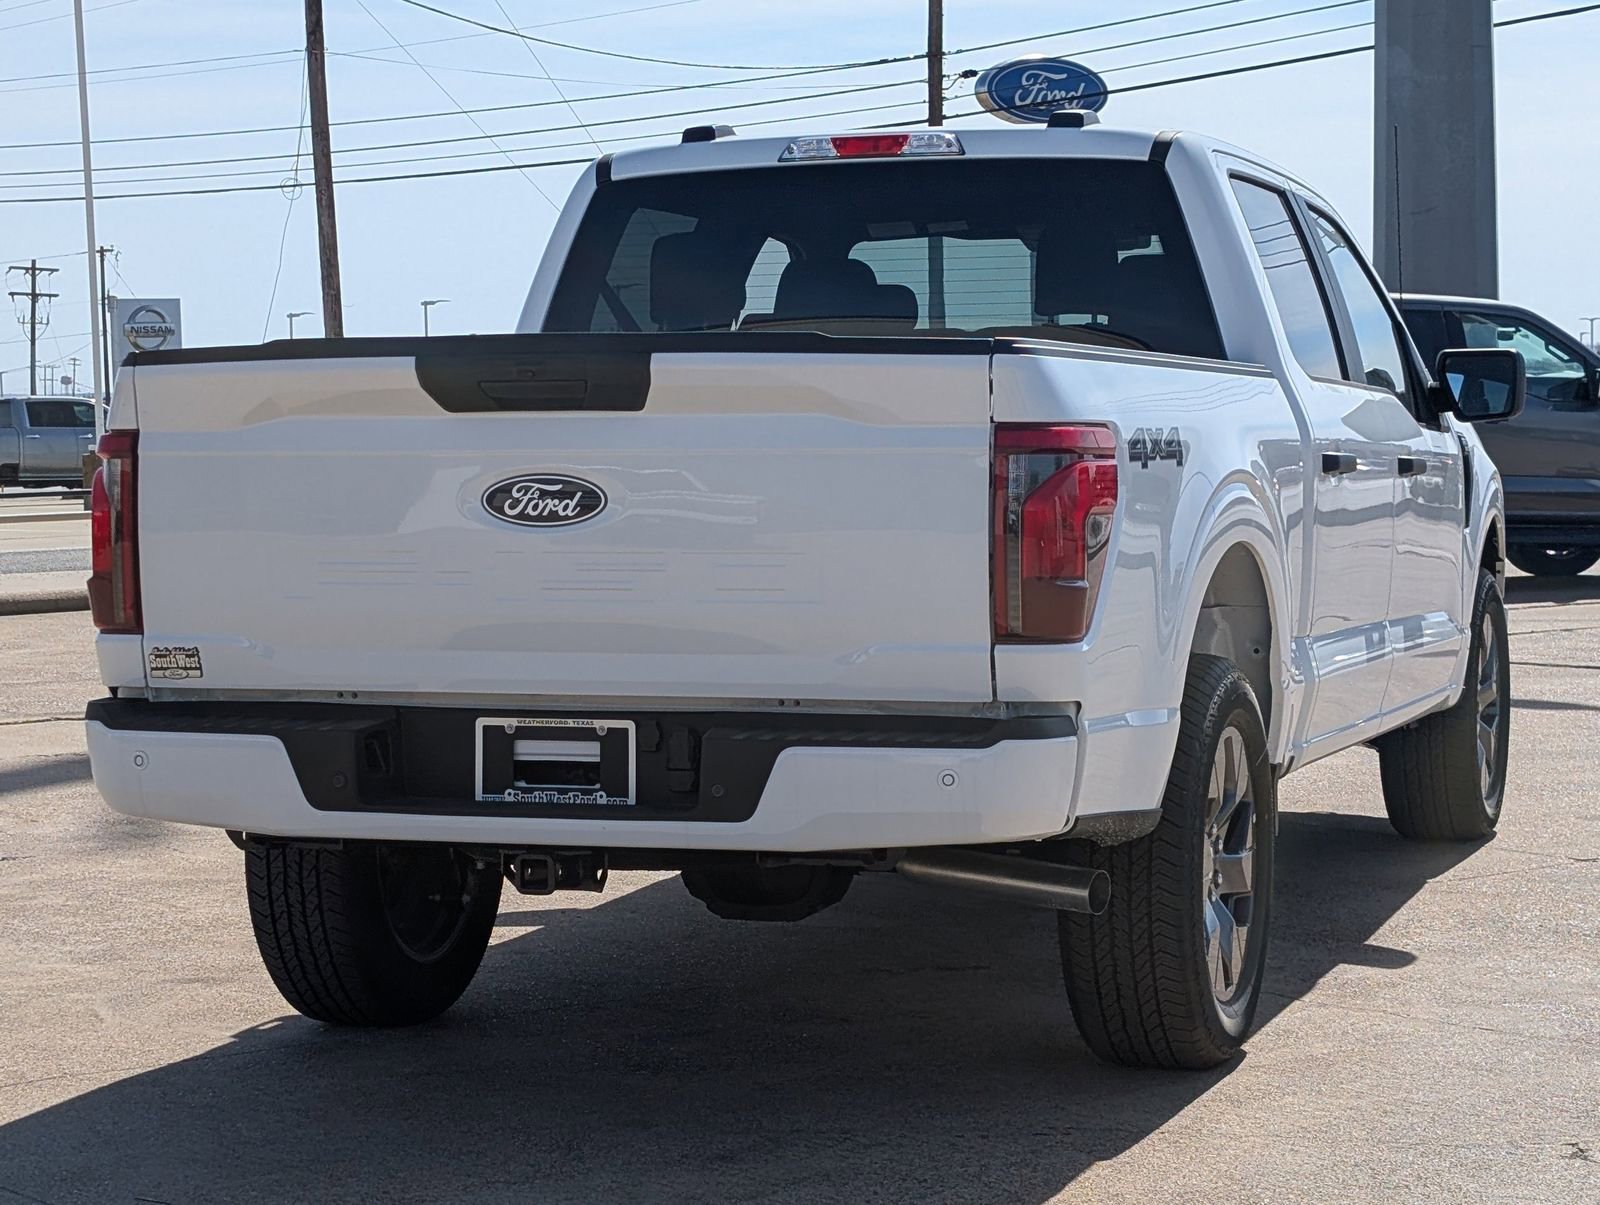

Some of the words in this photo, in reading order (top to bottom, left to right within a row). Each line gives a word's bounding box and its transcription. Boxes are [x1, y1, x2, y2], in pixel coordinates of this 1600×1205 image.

[1014, 70, 1085, 109] Ford
[130, 325, 172, 334] NISSAN
[504, 482, 582, 516] Ford
